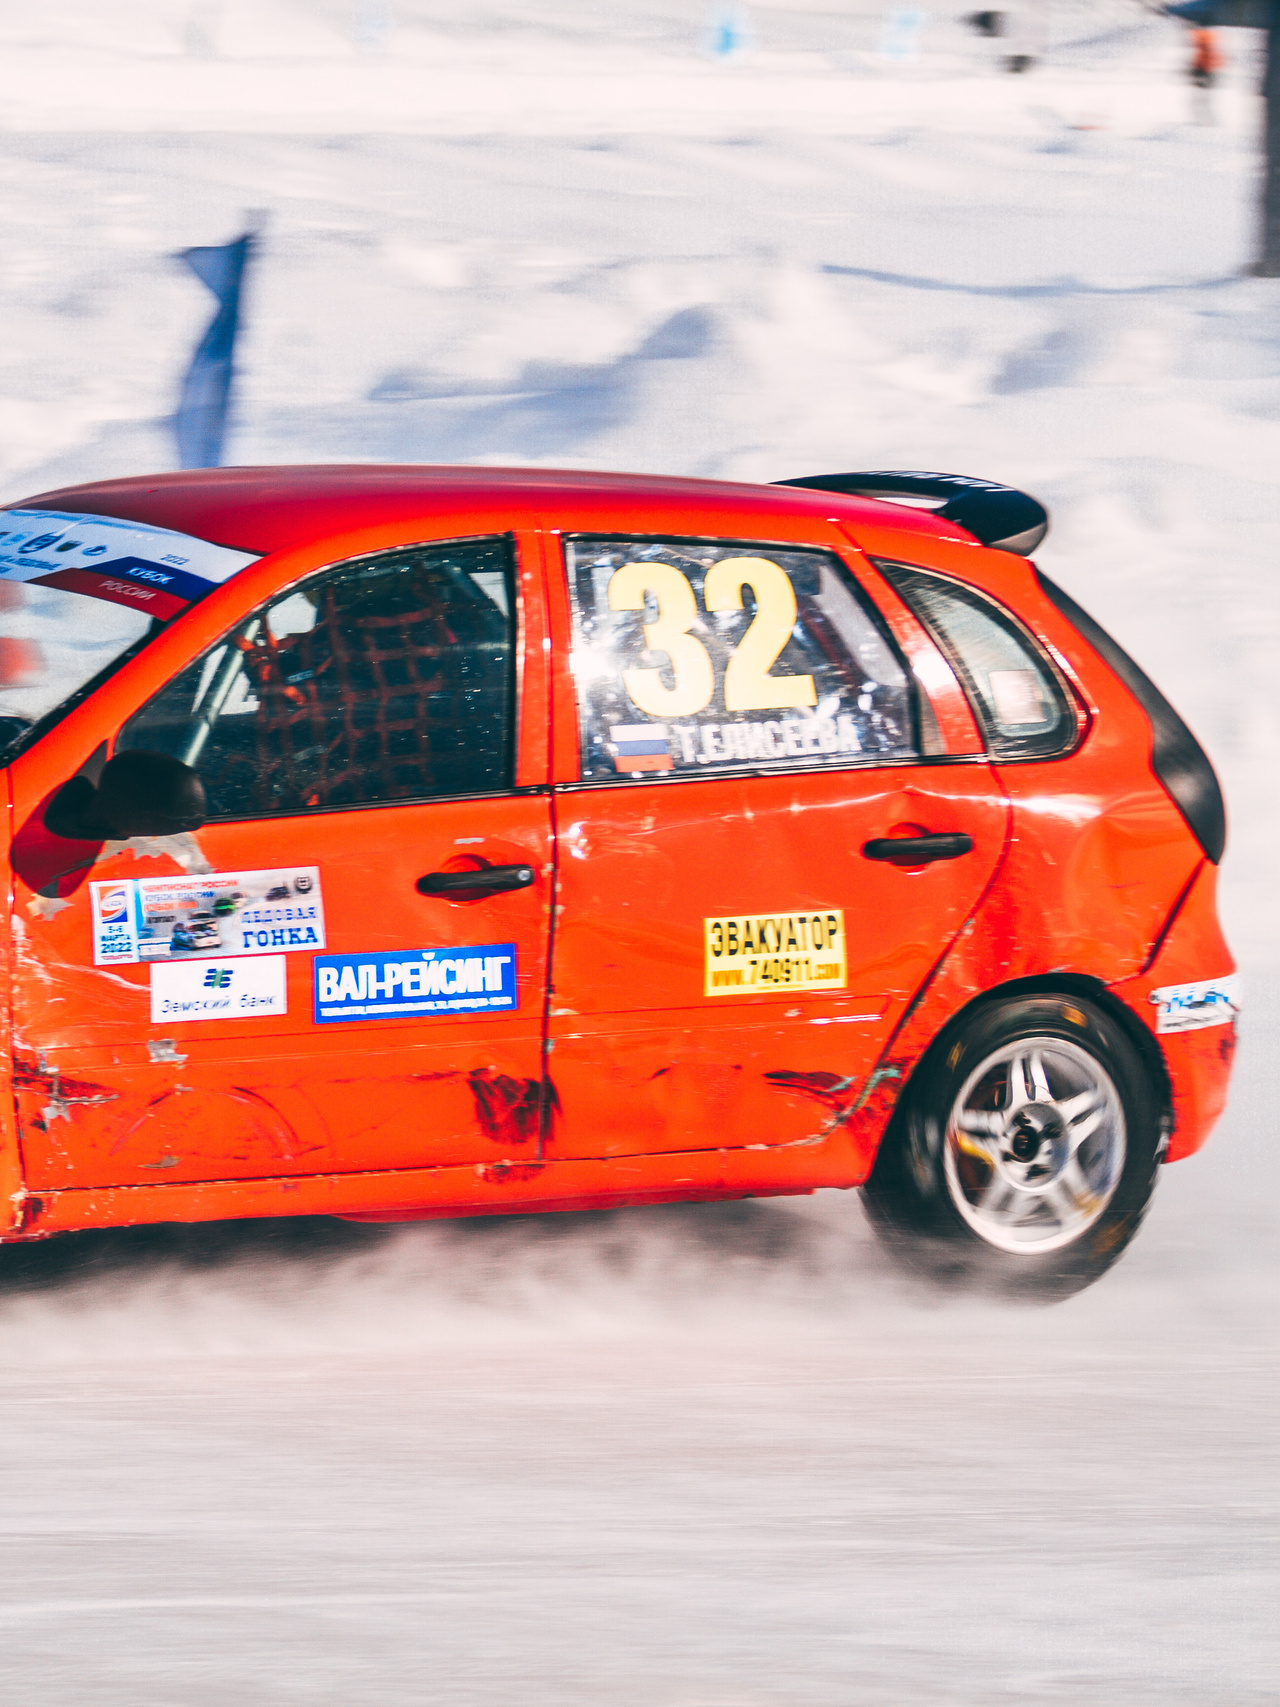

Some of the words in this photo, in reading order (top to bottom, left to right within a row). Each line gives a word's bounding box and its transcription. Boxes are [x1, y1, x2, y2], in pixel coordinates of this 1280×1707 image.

[125, 567, 175, 585] КУБОК
[98, 580, 157, 601] РОССИИ
[608, 556, 818, 717] 32
[241, 906, 318, 925] ЛЕДОВАЯ
[101, 934, 131, 942] МАРТА
[242, 927, 318, 949] ГОНКА
[712, 915, 838, 958] ЭВАКУАТОР
[101, 942, 132, 953] 2022
[318, 952, 511, 1002] ВАЛ-РЕЙСИНГ
[161, 995, 232, 1013] Земский
[239, 994, 277, 1008] банк
